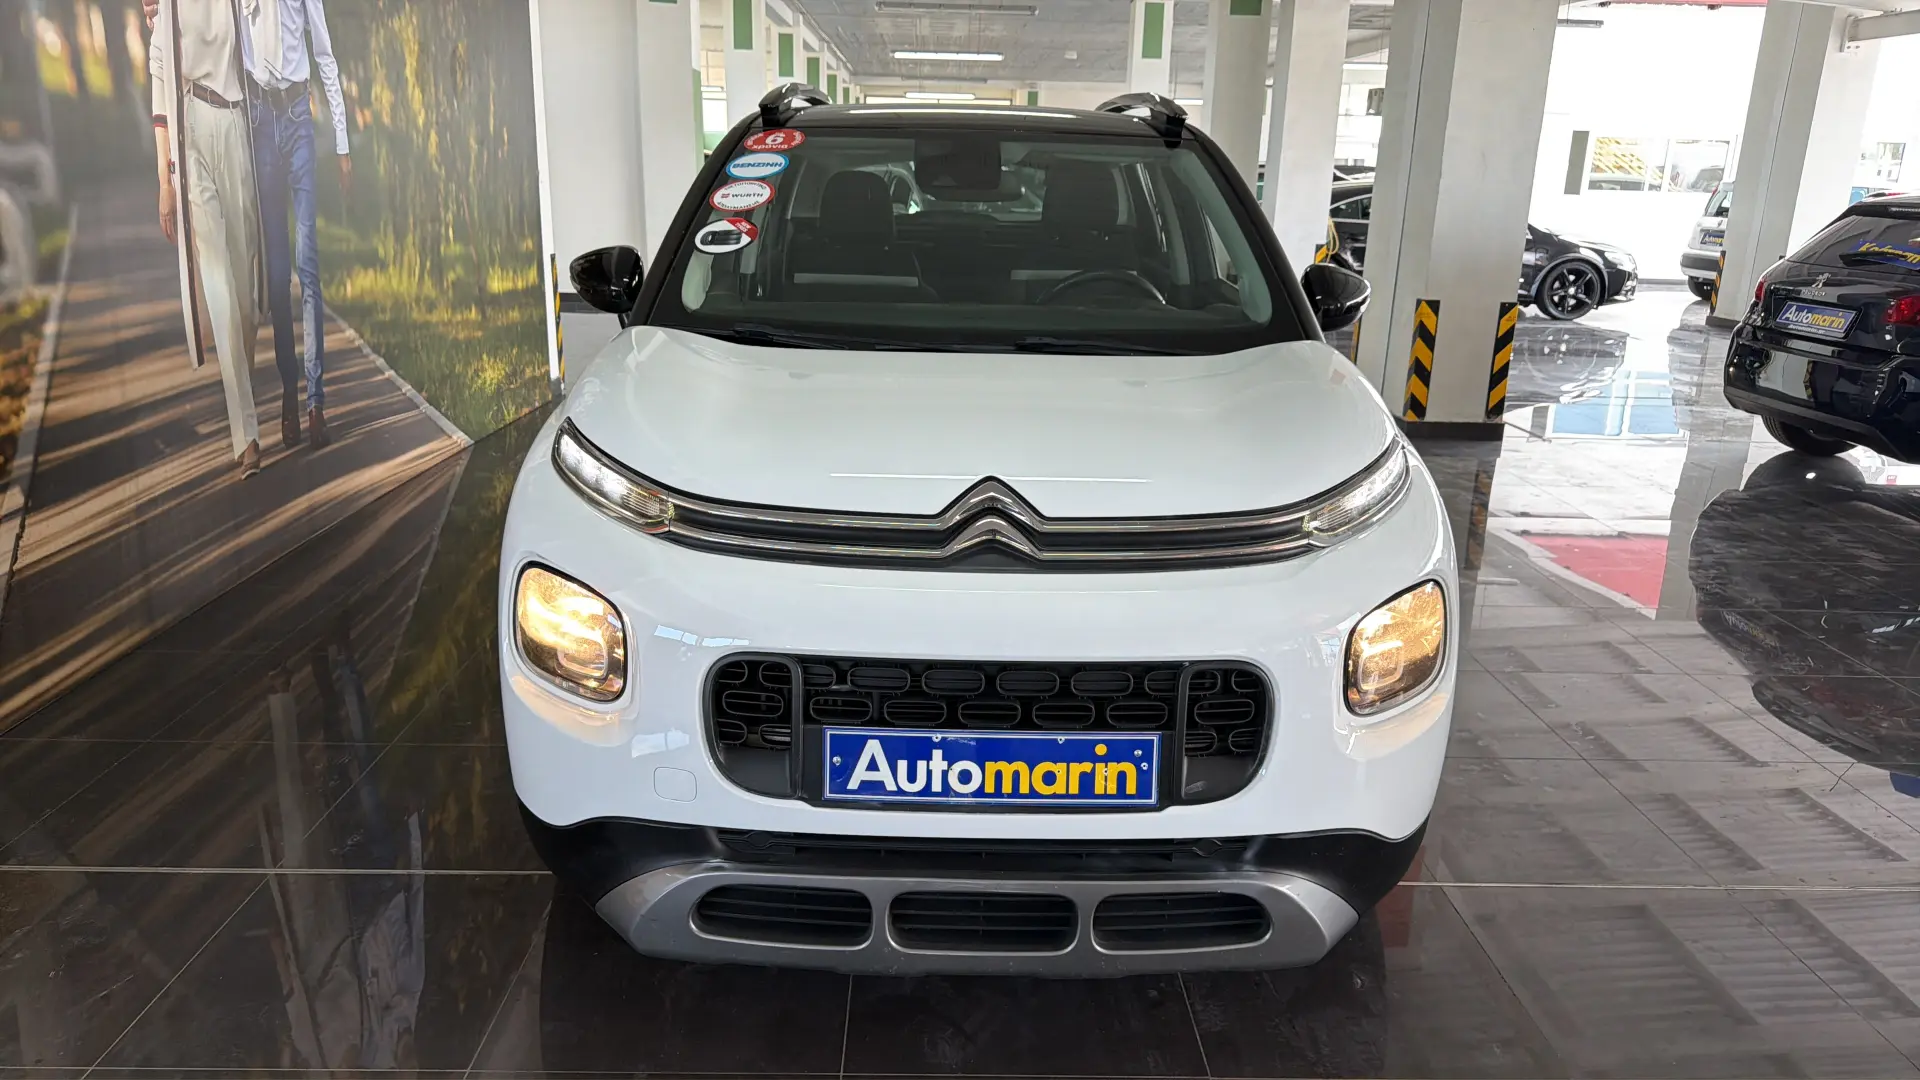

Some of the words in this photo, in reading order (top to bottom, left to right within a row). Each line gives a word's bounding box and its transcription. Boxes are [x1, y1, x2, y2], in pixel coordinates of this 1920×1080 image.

[765, 133, 785, 145] 6
[1782, 304, 1846, 329] Automarin
[846, 738, 1138, 796] Automarin
